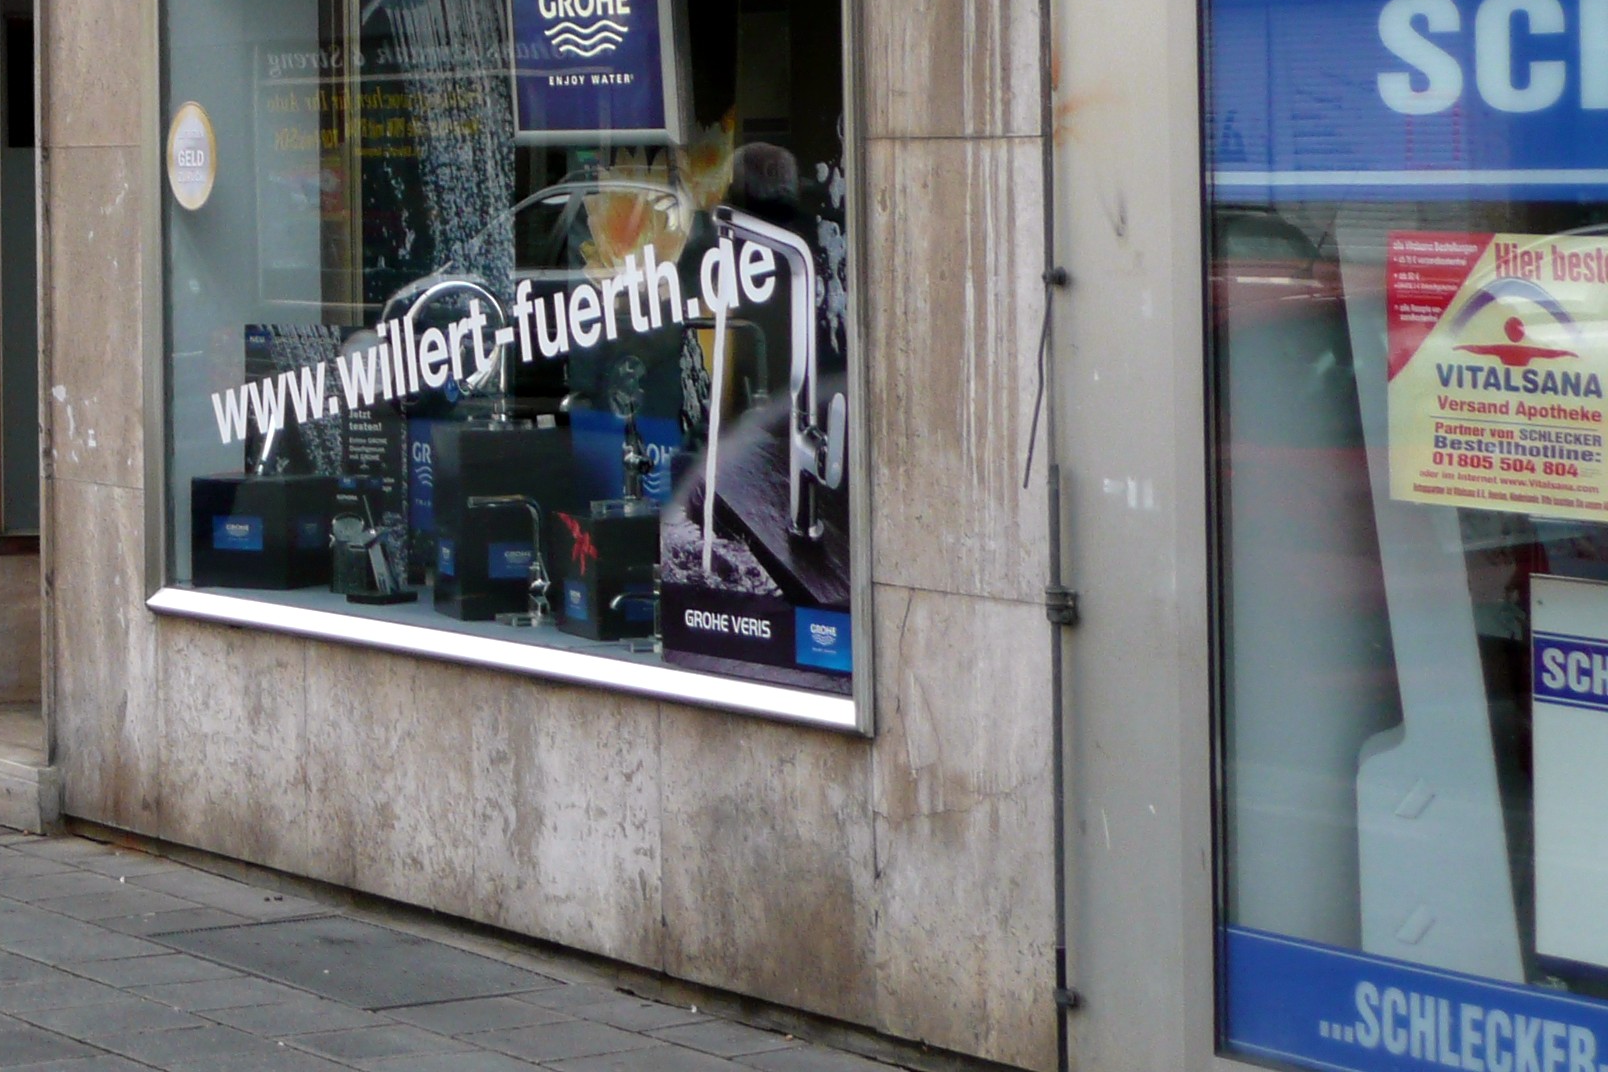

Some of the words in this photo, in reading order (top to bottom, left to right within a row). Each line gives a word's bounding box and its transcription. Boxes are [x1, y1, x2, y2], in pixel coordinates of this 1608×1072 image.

[549, 75, 585, 86] ENJOY
[178, 150, 204, 167] GELD
[1495, 242, 1543, 281] Hier
[1551, 244, 1608, 283] best
[211, 236, 776, 445] www.willert-fuerth.de
[1436, 363, 1603, 399] VITALSANA
[1437, 395, 1509, 416] Versand
[1515, 401, 1602, 423] Apotheke
[1435, 421, 1487, 438] Partner
[1489, 428, 1514, 440] von
[1519, 428, 1602, 447] SCHLECKER
[1434, 435, 1602, 463] Bestellhotline:
[1432, 451, 1493, 470] 01805
[1500, 457, 1536, 474] 504
[1543, 461, 1579, 478] 804
[1457, 473, 1497, 485] Internet
[685, 608, 730, 632] GROHE
[731, 615, 771, 638] VERIS
[810, 623, 837, 637] GROHE
